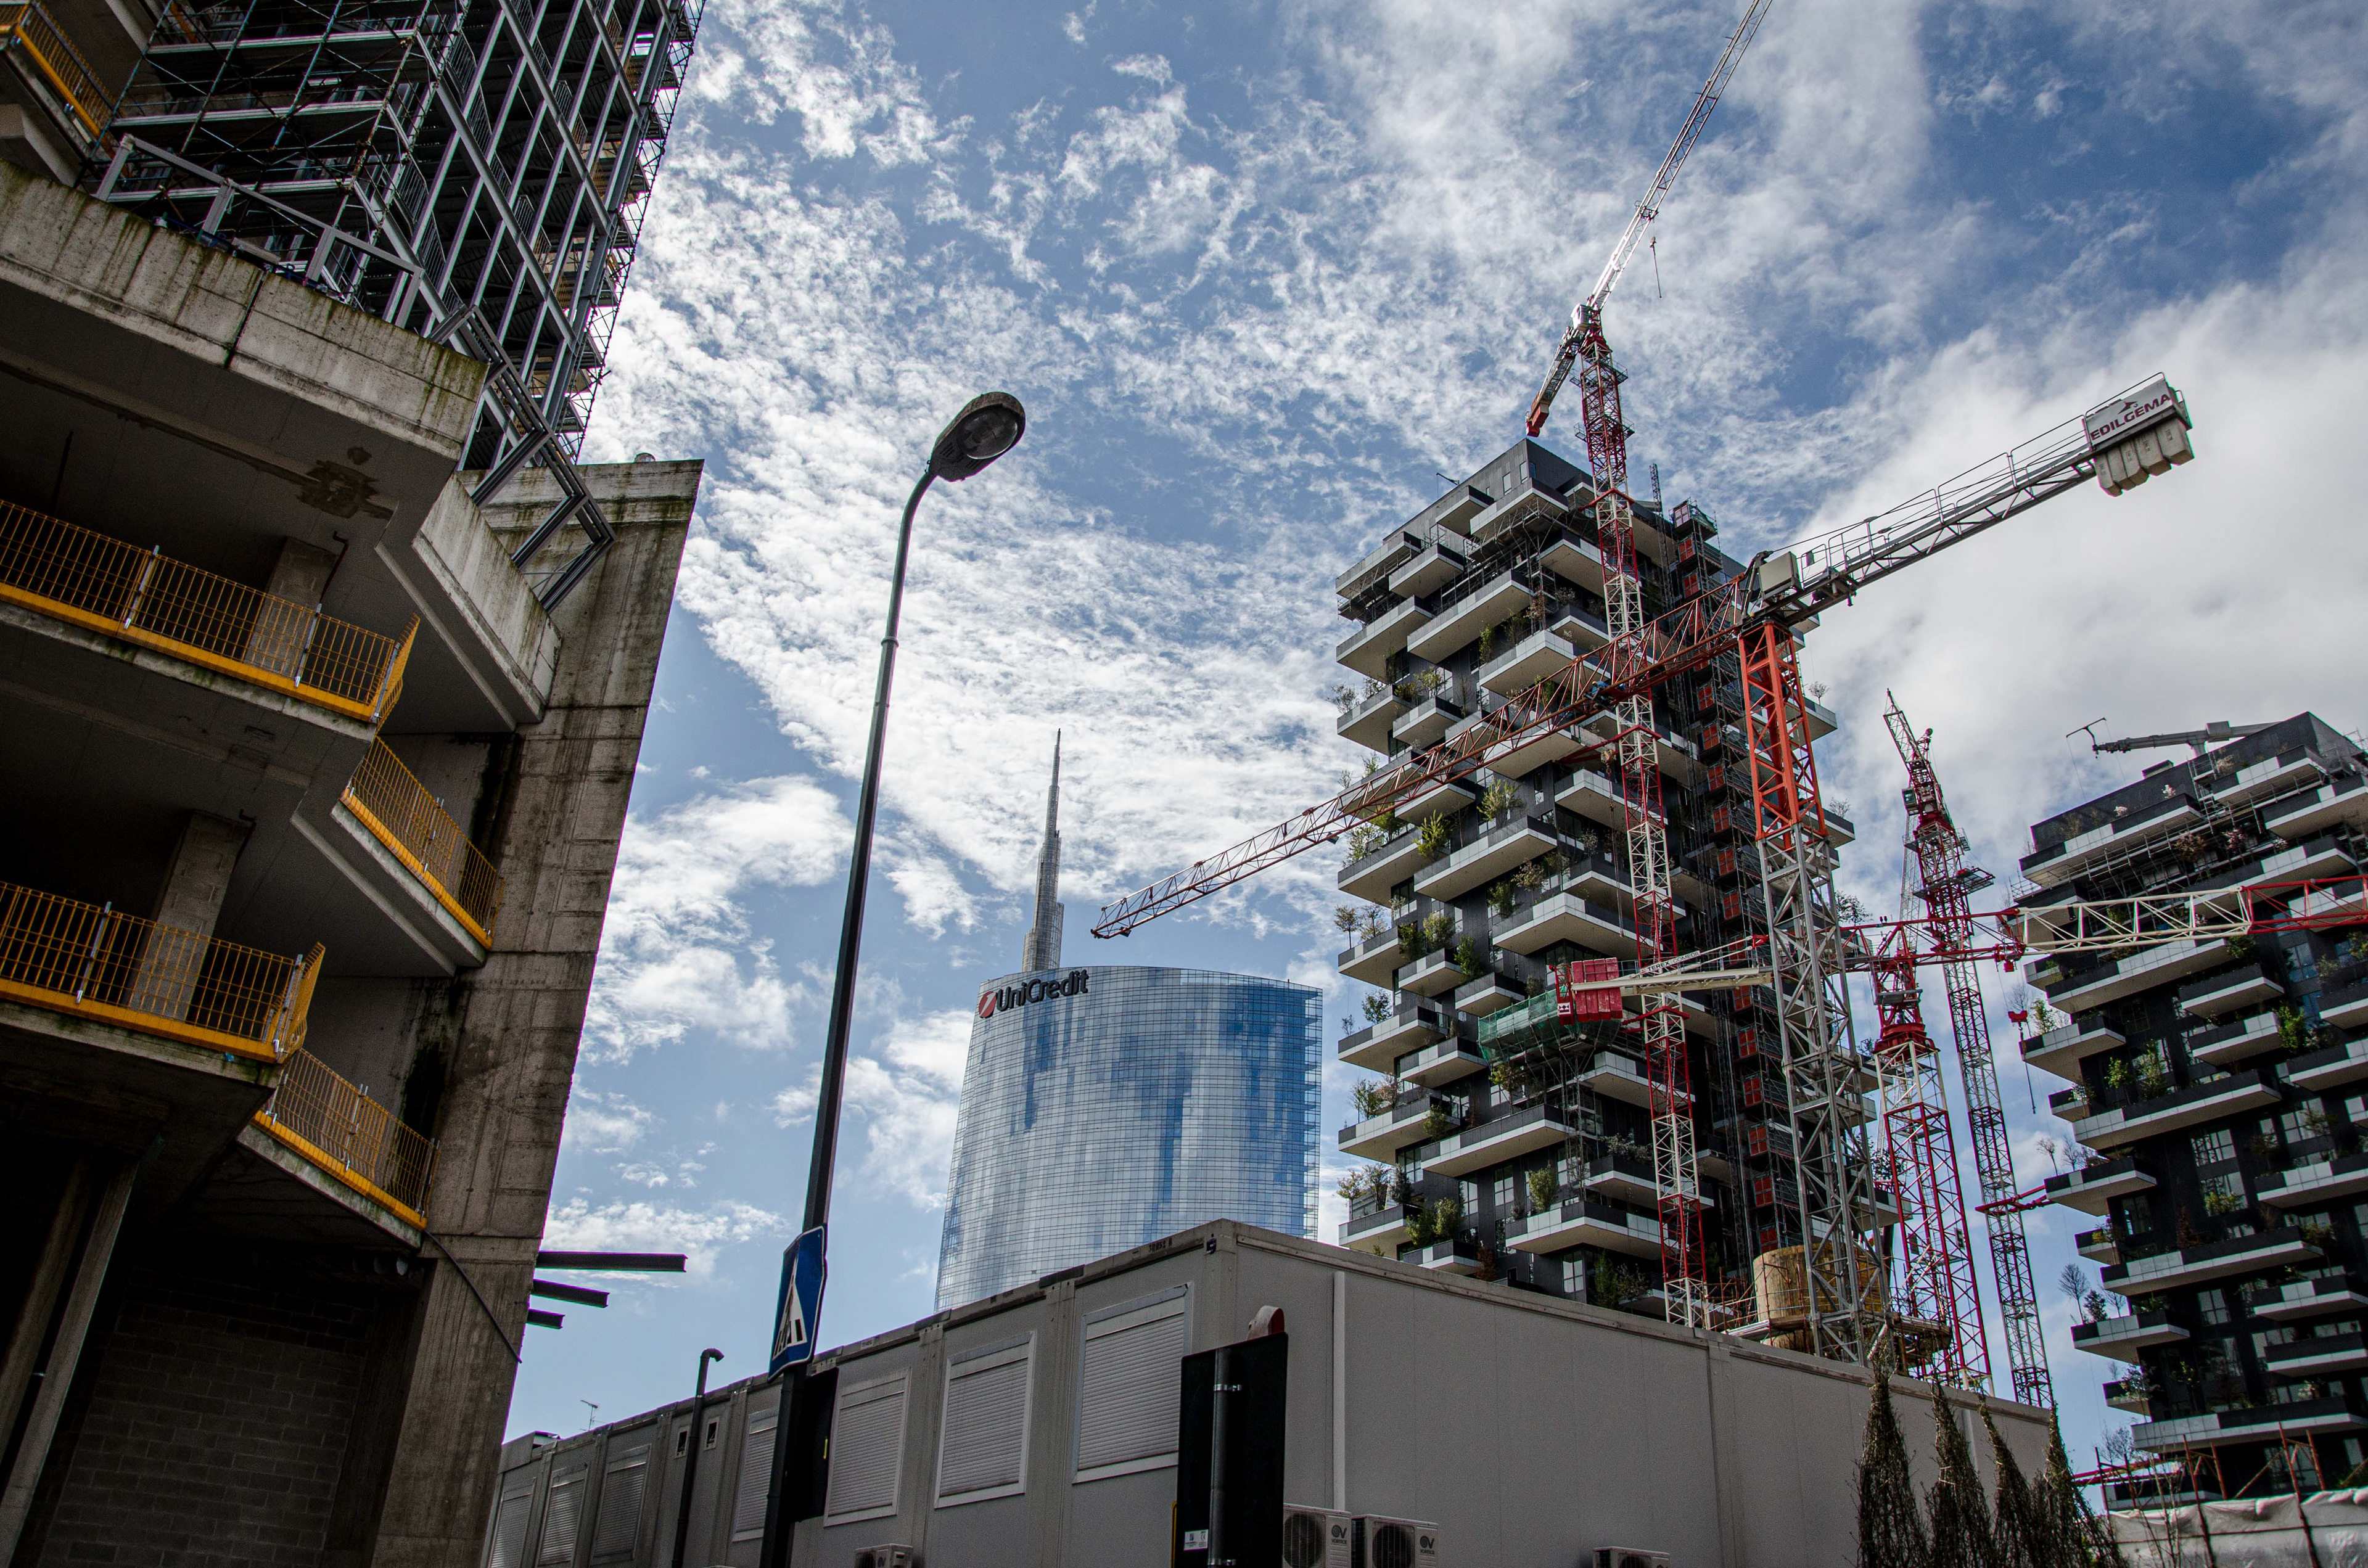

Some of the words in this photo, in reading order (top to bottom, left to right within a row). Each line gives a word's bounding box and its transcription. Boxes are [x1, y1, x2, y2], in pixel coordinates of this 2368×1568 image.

[2089, 394, 2171, 441] EDILGEMA
[1647, 961, 1670, 971] TEREX
[1672, 951, 1699, 964] COMEDIL
[997, 969, 1089, 1011] UniCredit
